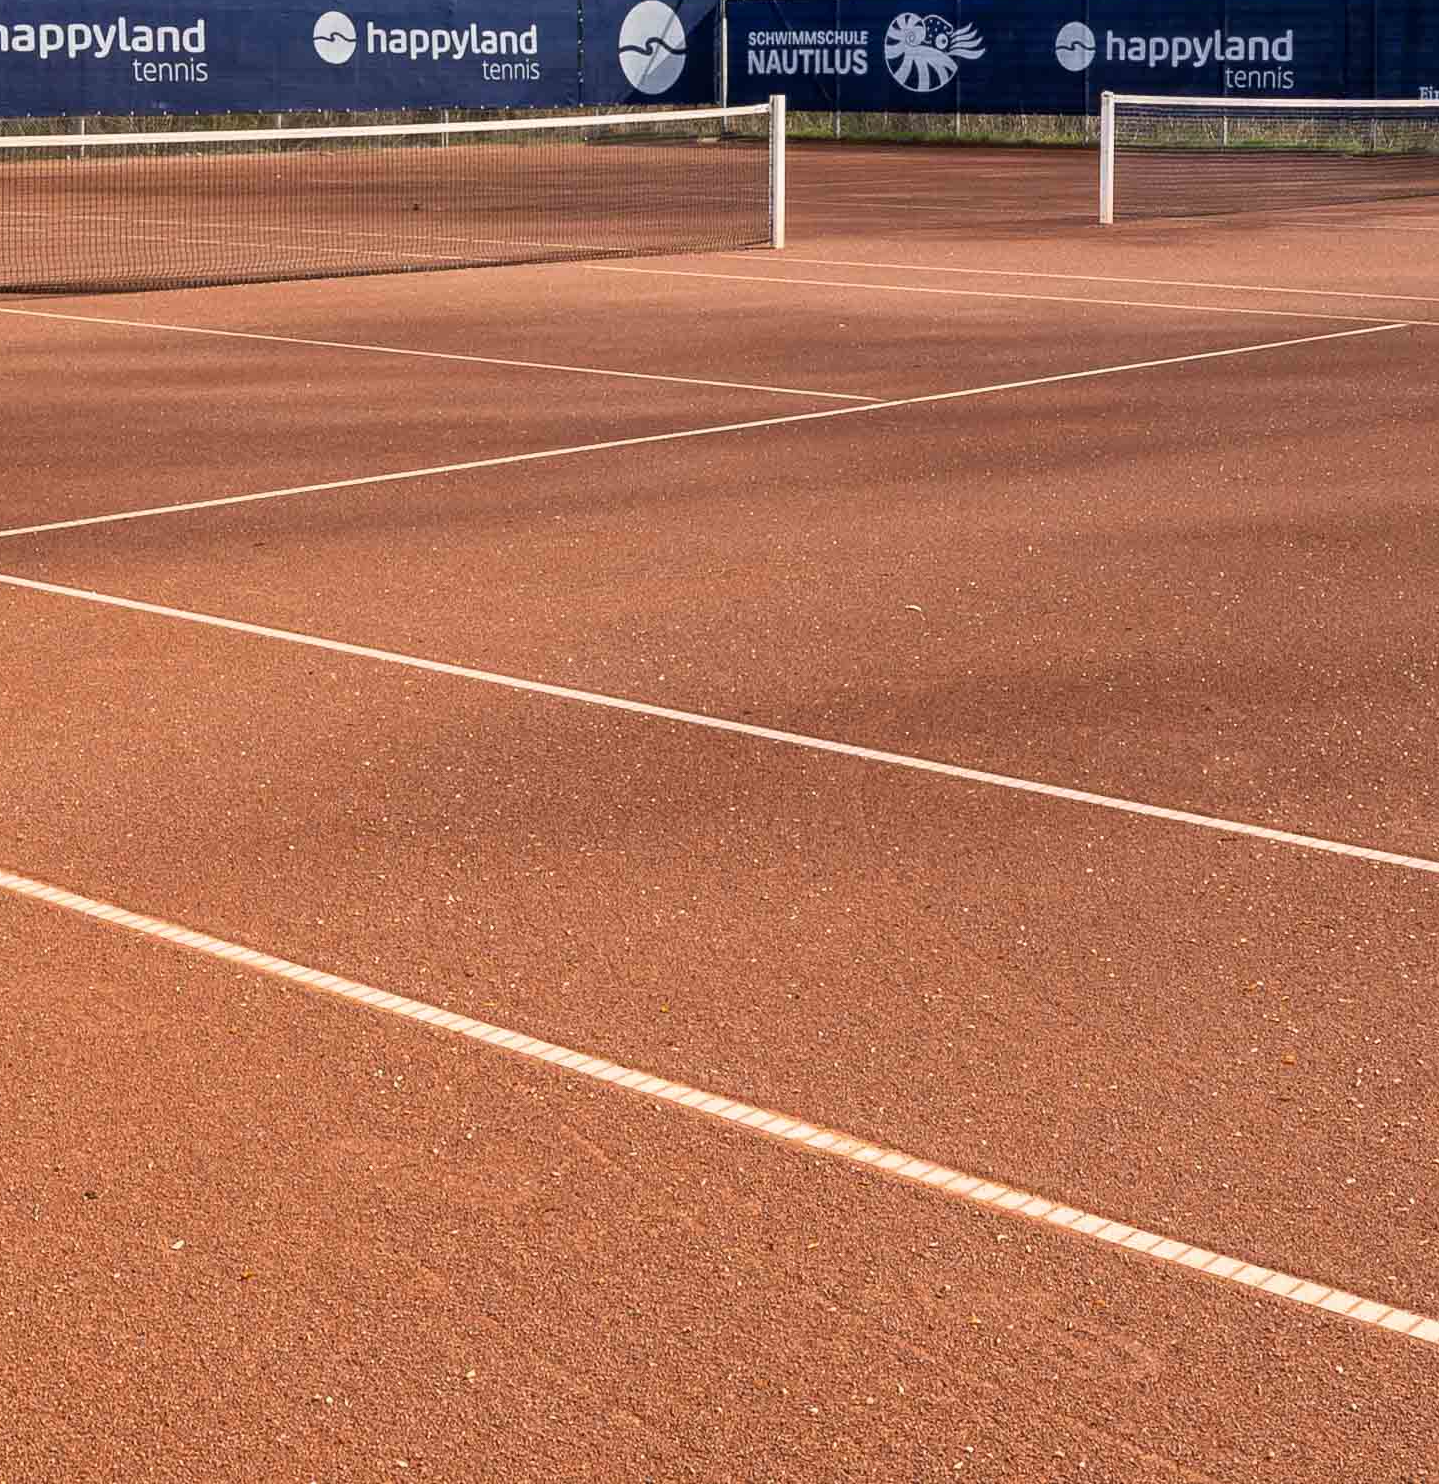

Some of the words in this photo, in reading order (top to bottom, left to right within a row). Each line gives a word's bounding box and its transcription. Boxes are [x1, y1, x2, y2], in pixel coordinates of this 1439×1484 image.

[367, 21, 538, 59] happyland
[748, 29, 869, 46] SCHWIMMSCHULE
[1106, 29, 1293, 68] happyland
[132, 57, 208, 82] tennis
[482, 58, 541, 81] tennis
[747, 48, 868, 75] NAUTILUS
[1224, 66, 1294, 90] tennis
